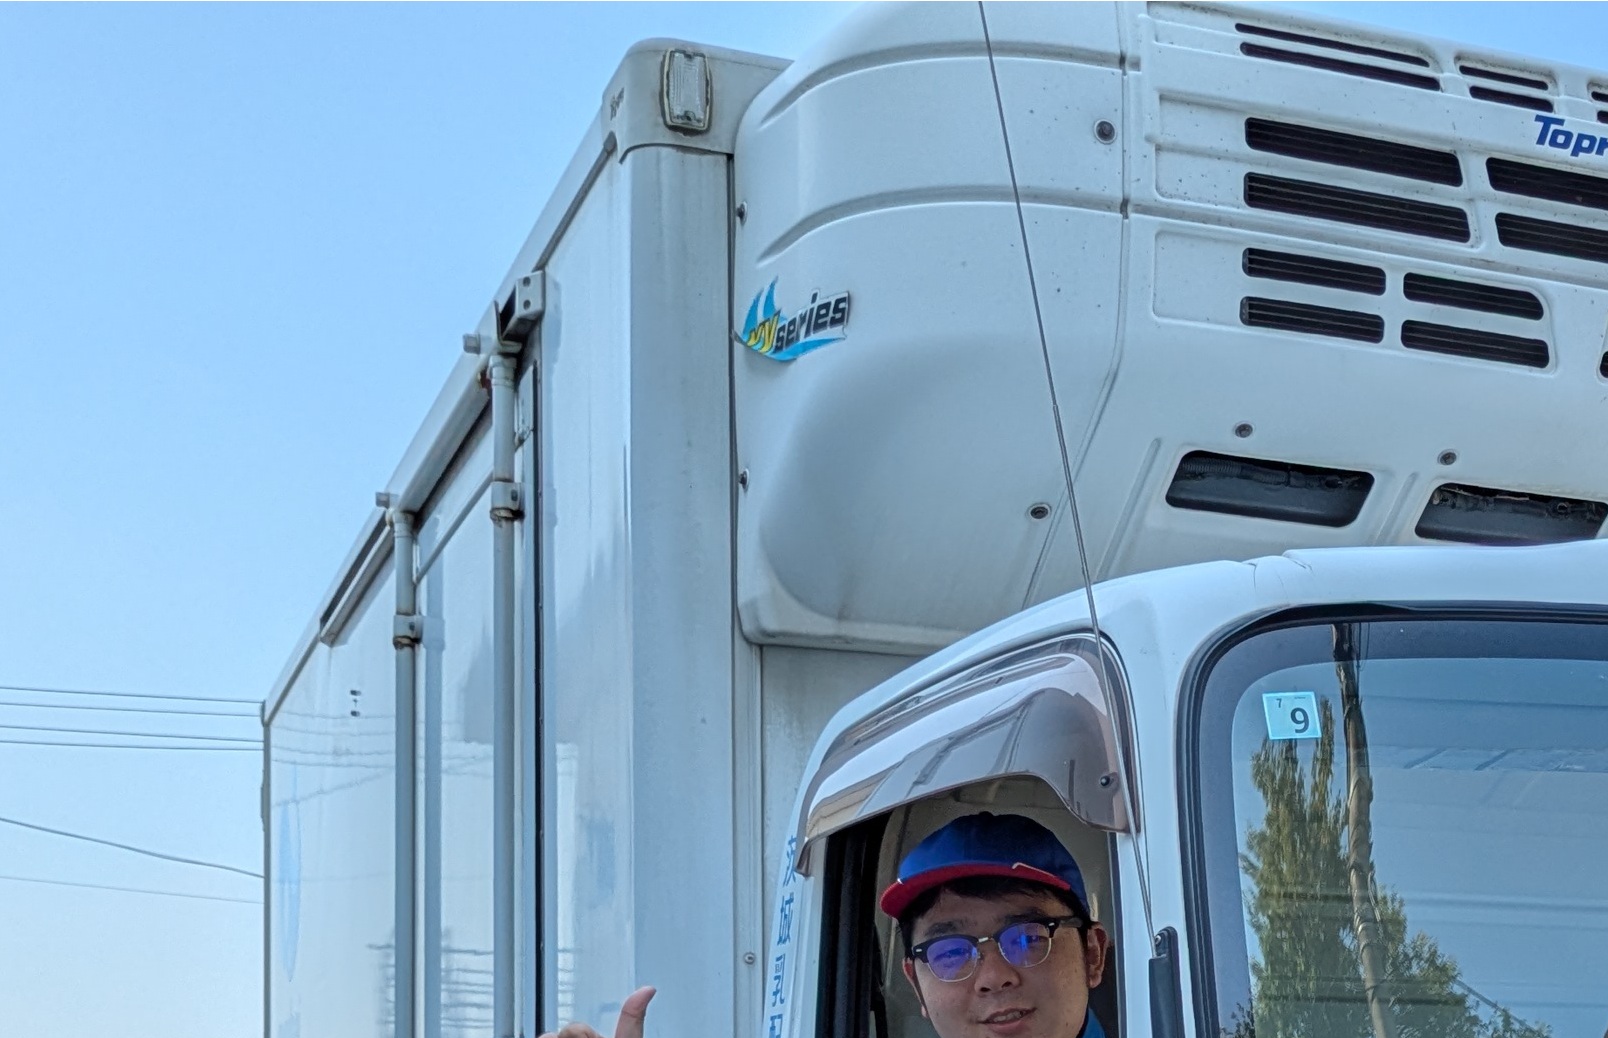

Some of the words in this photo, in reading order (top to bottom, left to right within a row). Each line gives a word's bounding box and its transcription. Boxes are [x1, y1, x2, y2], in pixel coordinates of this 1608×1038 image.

[773, 291, 849, 354] series
[1275, 698, 1282, 708] 7
[1290, 707, 1310, 734] 9
